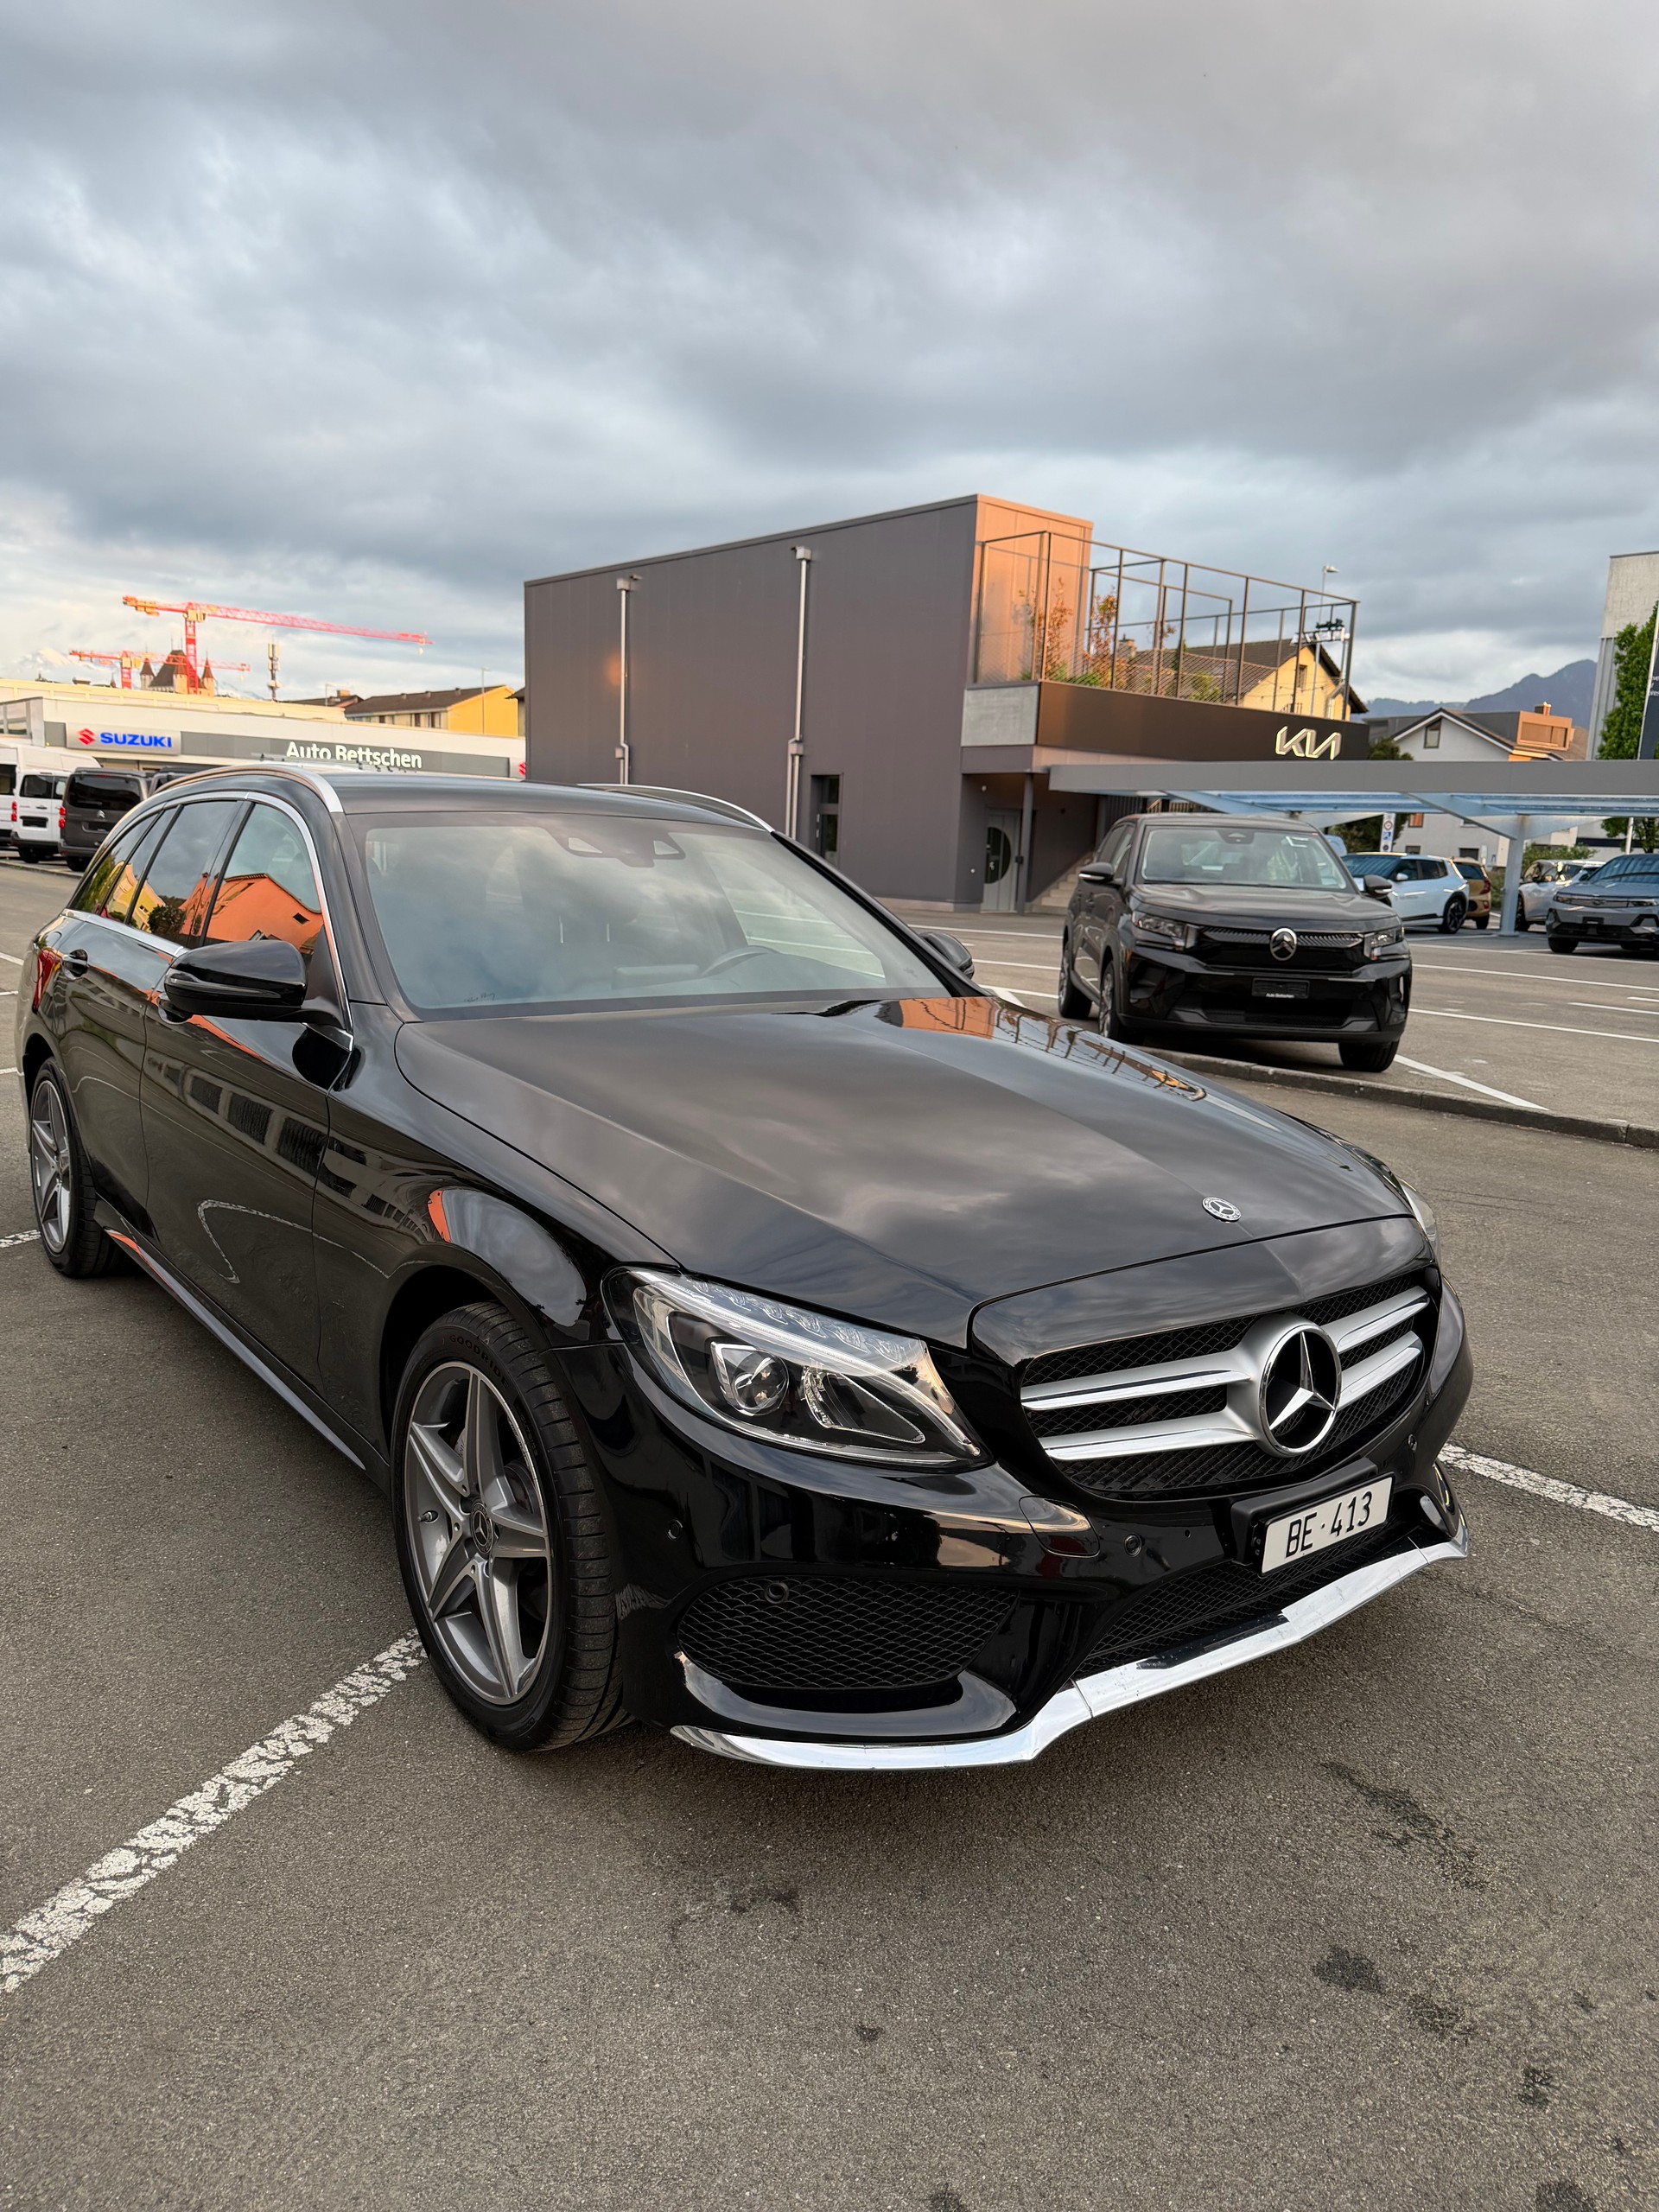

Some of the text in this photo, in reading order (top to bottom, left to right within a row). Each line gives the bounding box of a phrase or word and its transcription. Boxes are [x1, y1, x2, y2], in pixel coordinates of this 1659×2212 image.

[99, 732, 172, 748] SUZUKI
[286, 741, 423, 769] Auto Bettschen
[1274, 725, 1342, 760] KIA
[449, 1334, 510, 1389] GOODRIDE
[1285, 1511, 1318, 1559] BE
[1329, 1491, 1373, 1537] 413
